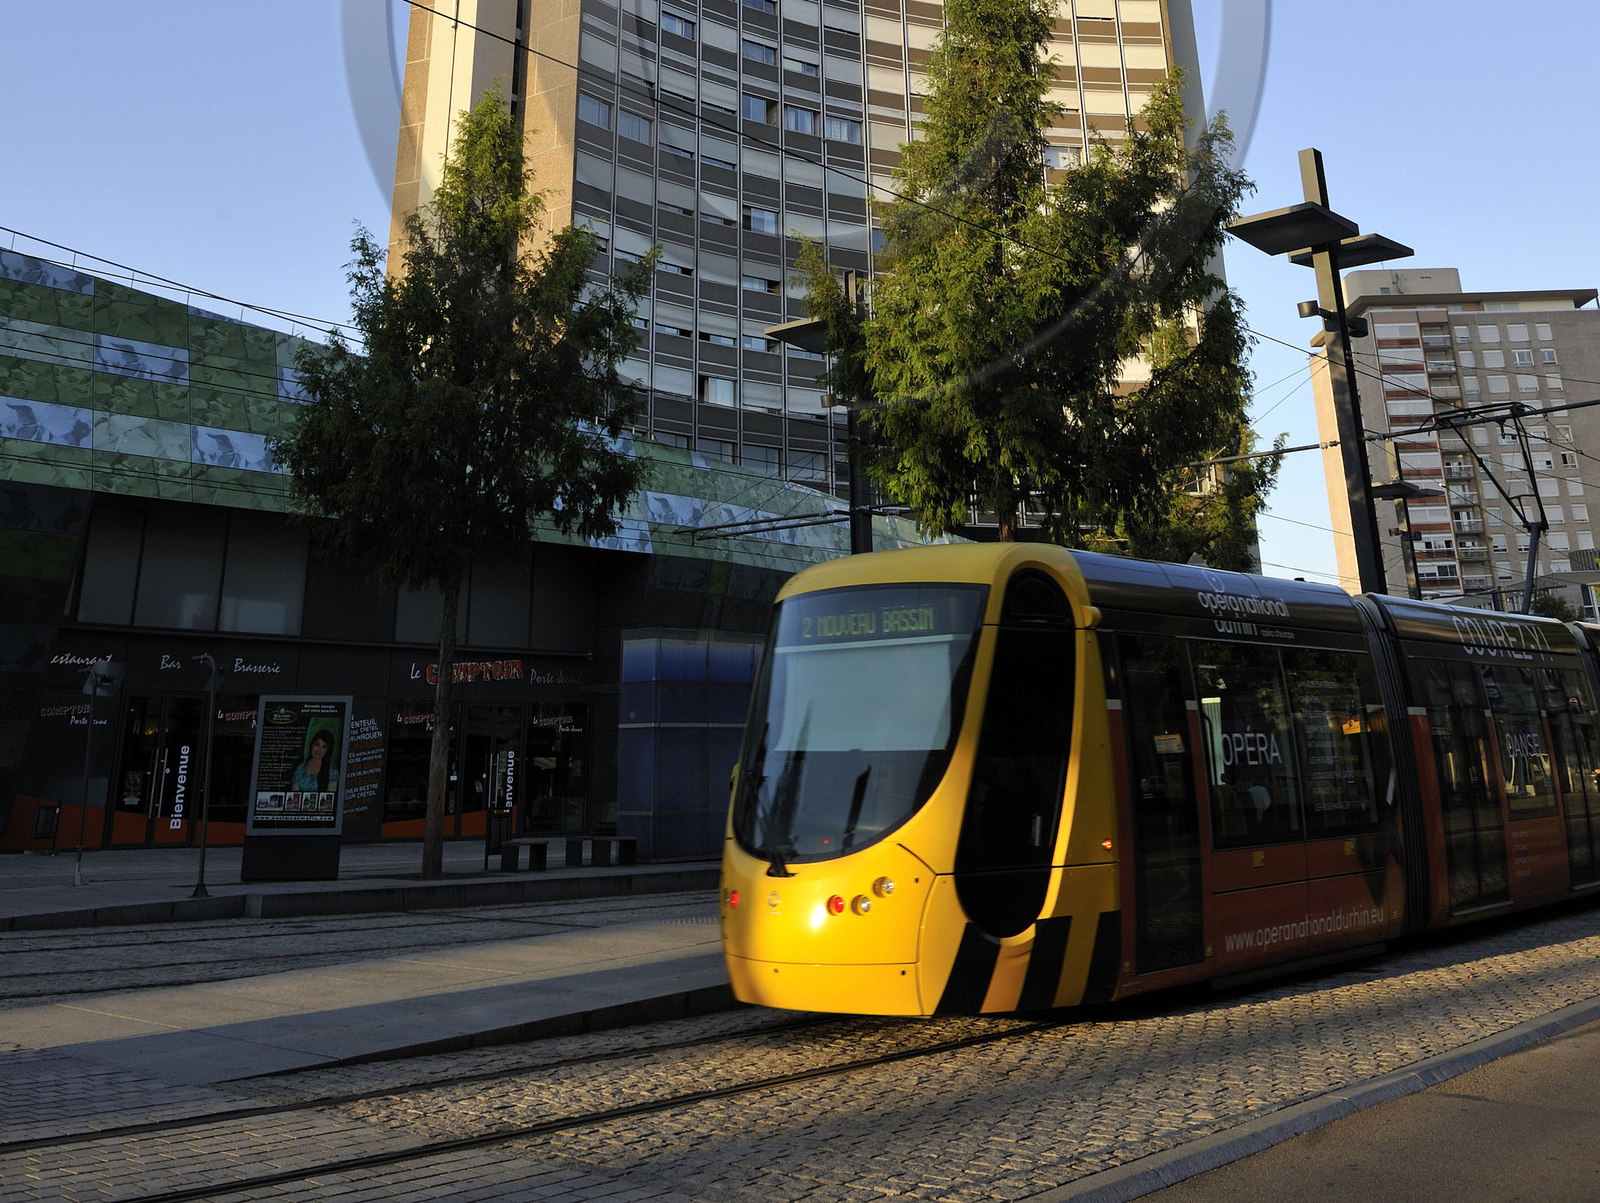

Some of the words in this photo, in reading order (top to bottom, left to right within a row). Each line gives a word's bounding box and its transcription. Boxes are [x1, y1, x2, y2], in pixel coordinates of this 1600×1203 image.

[802, 617, 813, 639] 2
[817, 612, 877, 637] NOUVEAU
[882, 607, 935, 633] BASSIN
[160, 655, 182, 671] Bar
[233, 658, 281, 674] Brasserie
[410, 662, 423, 680] Le
[426, 659, 523, 686] CMPTOIR
[1221, 724, 1283, 766] OPÉRA
[169, 745, 190, 830] Bienvenue
[1224, 904, 1384, 952] www.operanationaldurhin.eu
